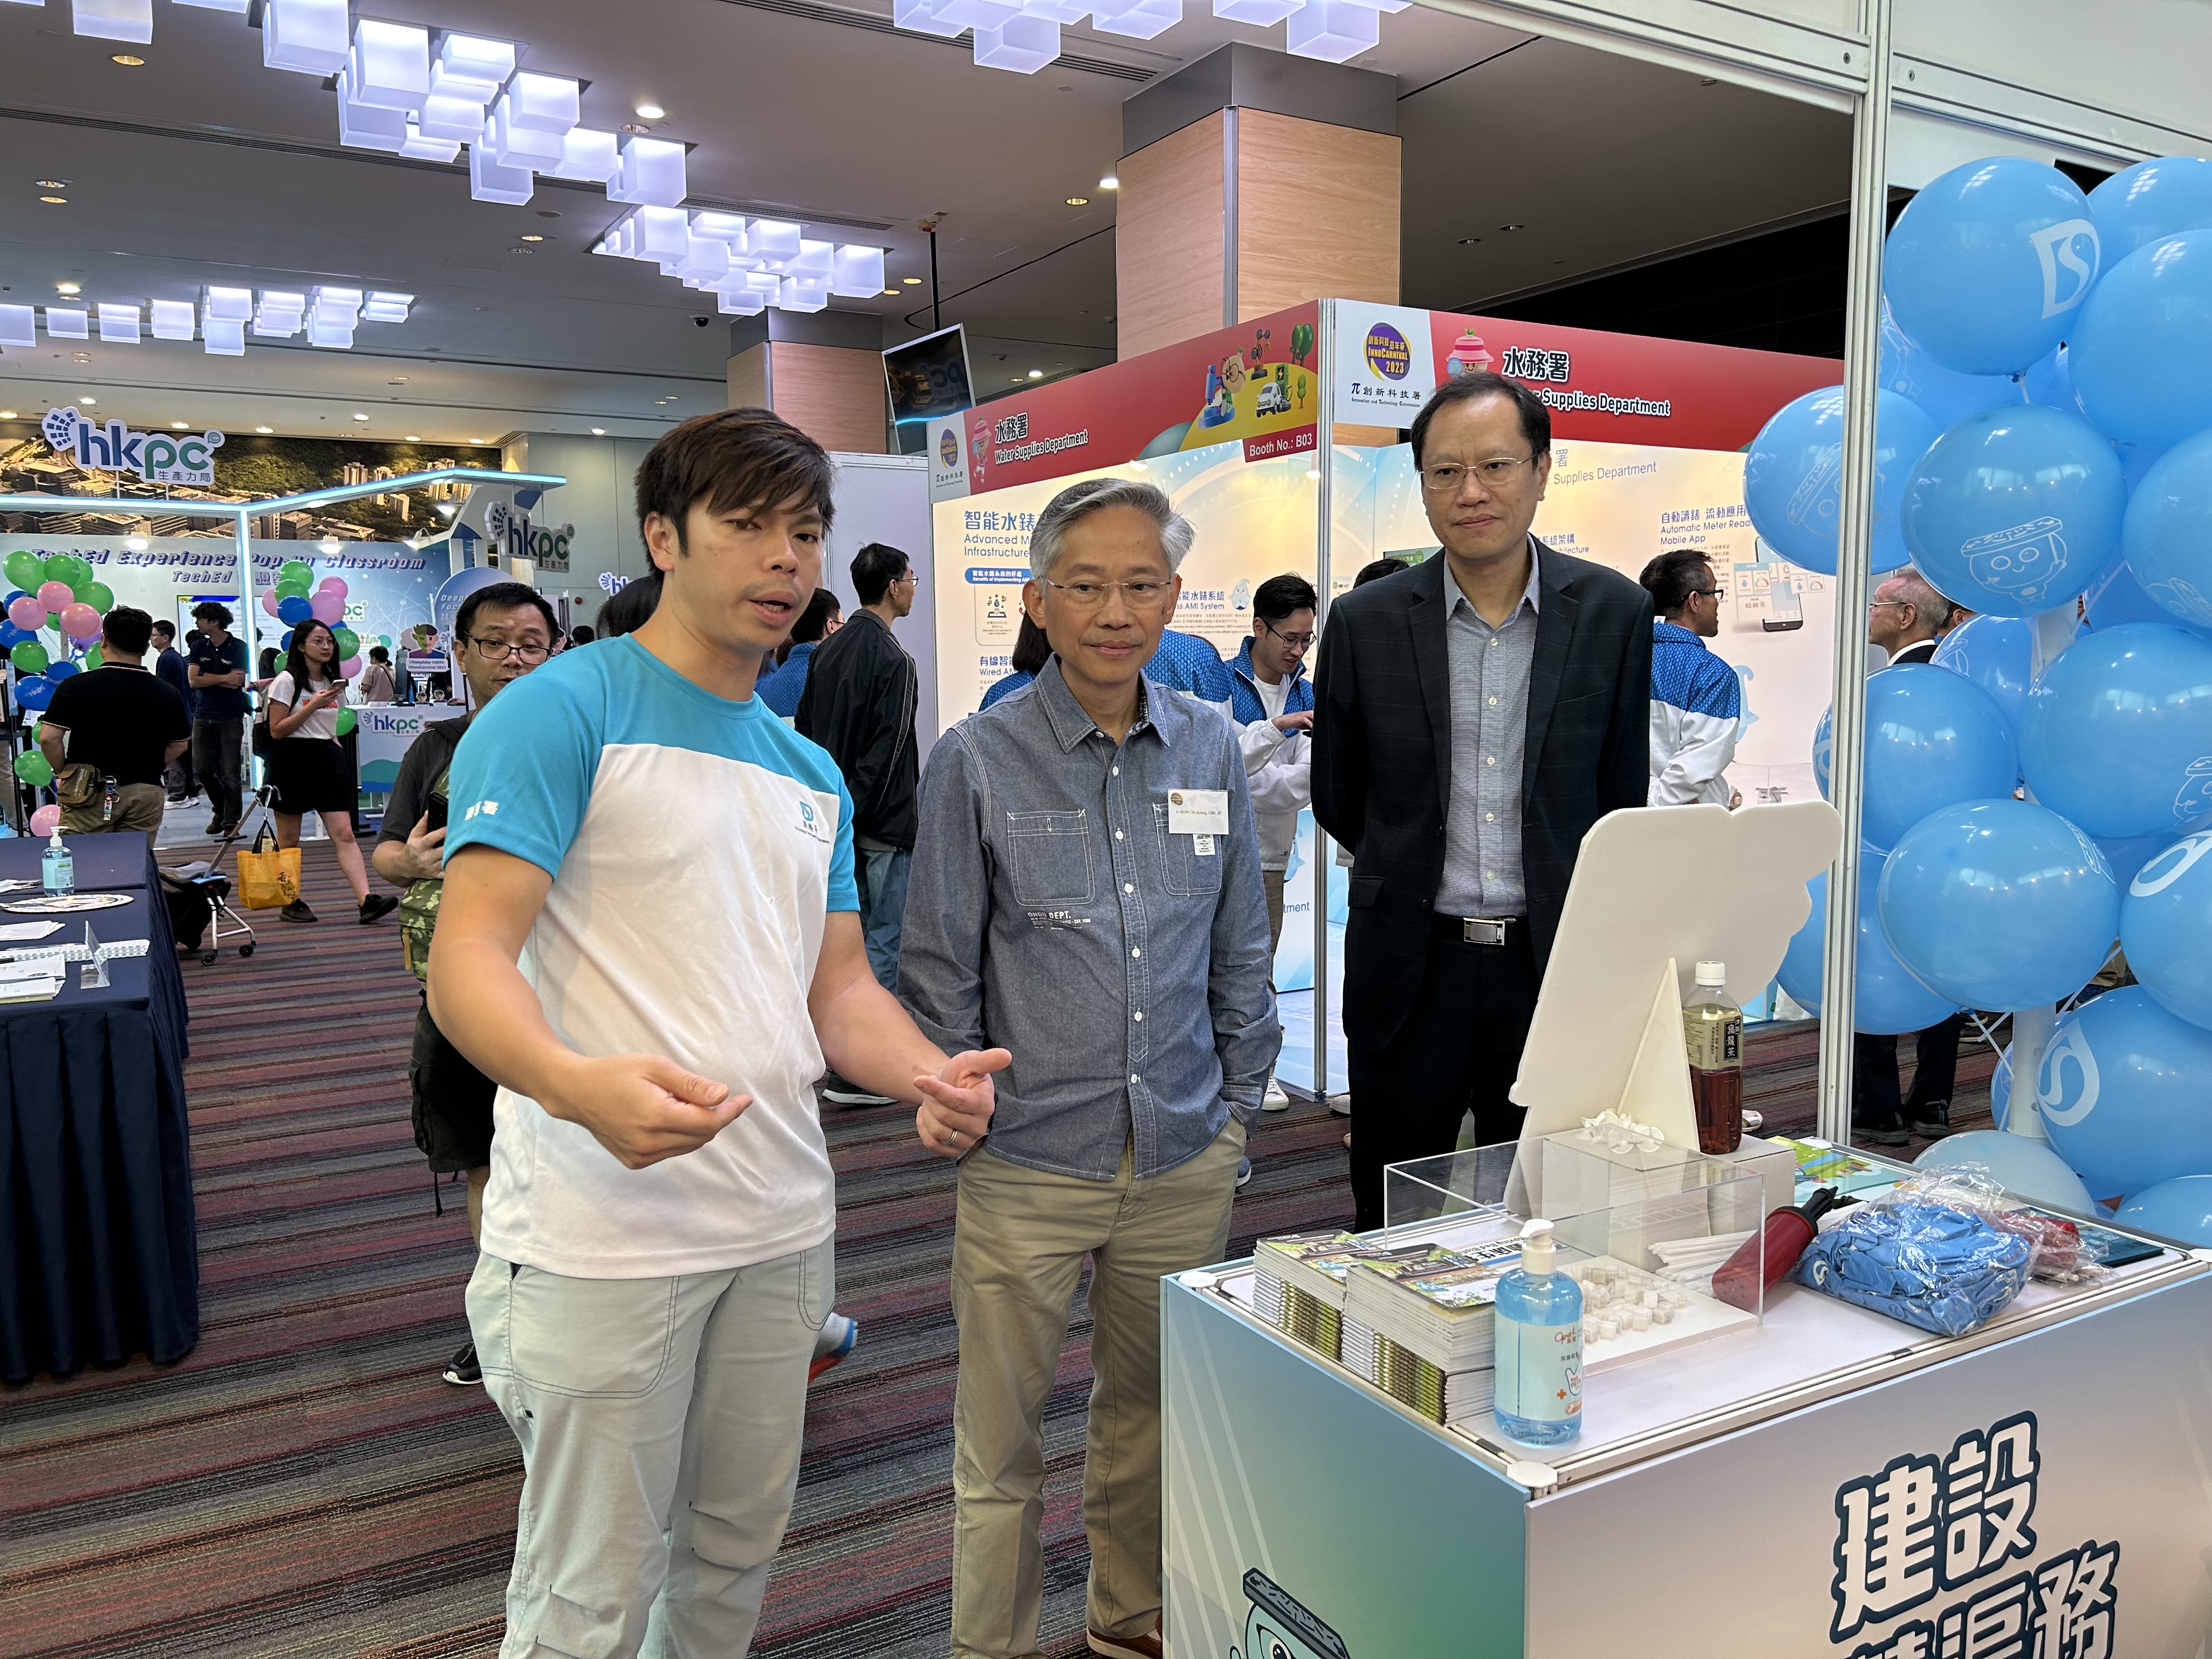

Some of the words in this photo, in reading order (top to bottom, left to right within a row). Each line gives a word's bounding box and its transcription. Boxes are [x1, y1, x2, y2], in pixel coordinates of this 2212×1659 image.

[1386, 361, 1404, 374] 2023
[1503, 348, 1568, 381] 水務署
[1363, 387, 1421, 400] 創新科技署
[1543, 389, 1596, 410] Supplies
[1600, 394, 1670, 414] Department
[995, 413, 1028, 442] 水務署
[79, 423, 210, 479] hkpc
[995, 450, 1014, 464] Water
[1015, 442, 1044, 460] Supplies
[1045, 430, 1088, 453] Department
[1249, 441, 1274, 456] Booth
[1277, 439, 1293, 452] No.:
[1296, 432, 1312, 448] B03
[158, 470, 211, 482] 生產力局
[1554, 470, 1594, 486] Supplies
[1597, 461, 1657, 480] Department
[964, 511, 1041, 531] 智能水錶
[1662, 509, 1700, 524] 自動讀錶
[1661, 523, 1701, 534] Automatic
[1703, 522, 1727, 531] Meter
[507, 516, 568, 567] hkpc
[964, 534, 1018, 545] Advanced
[1538, 534, 1575, 546] 系統架構
[1661, 535, 1687, 545] Mobile
[1689, 535, 1706, 544] App
[32, 549, 110, 565] TehEd
[117, 550, 238, 567] Experience
[324, 554, 426, 569] Classroom
[964, 546, 1029, 557] Infrastructure
[172, 571, 233, 583] TechEd
[1200, 602, 1224, 611] System
[374, 715, 419, 734] hkpc
[1831, 1412, 2039, 1643] 建設
